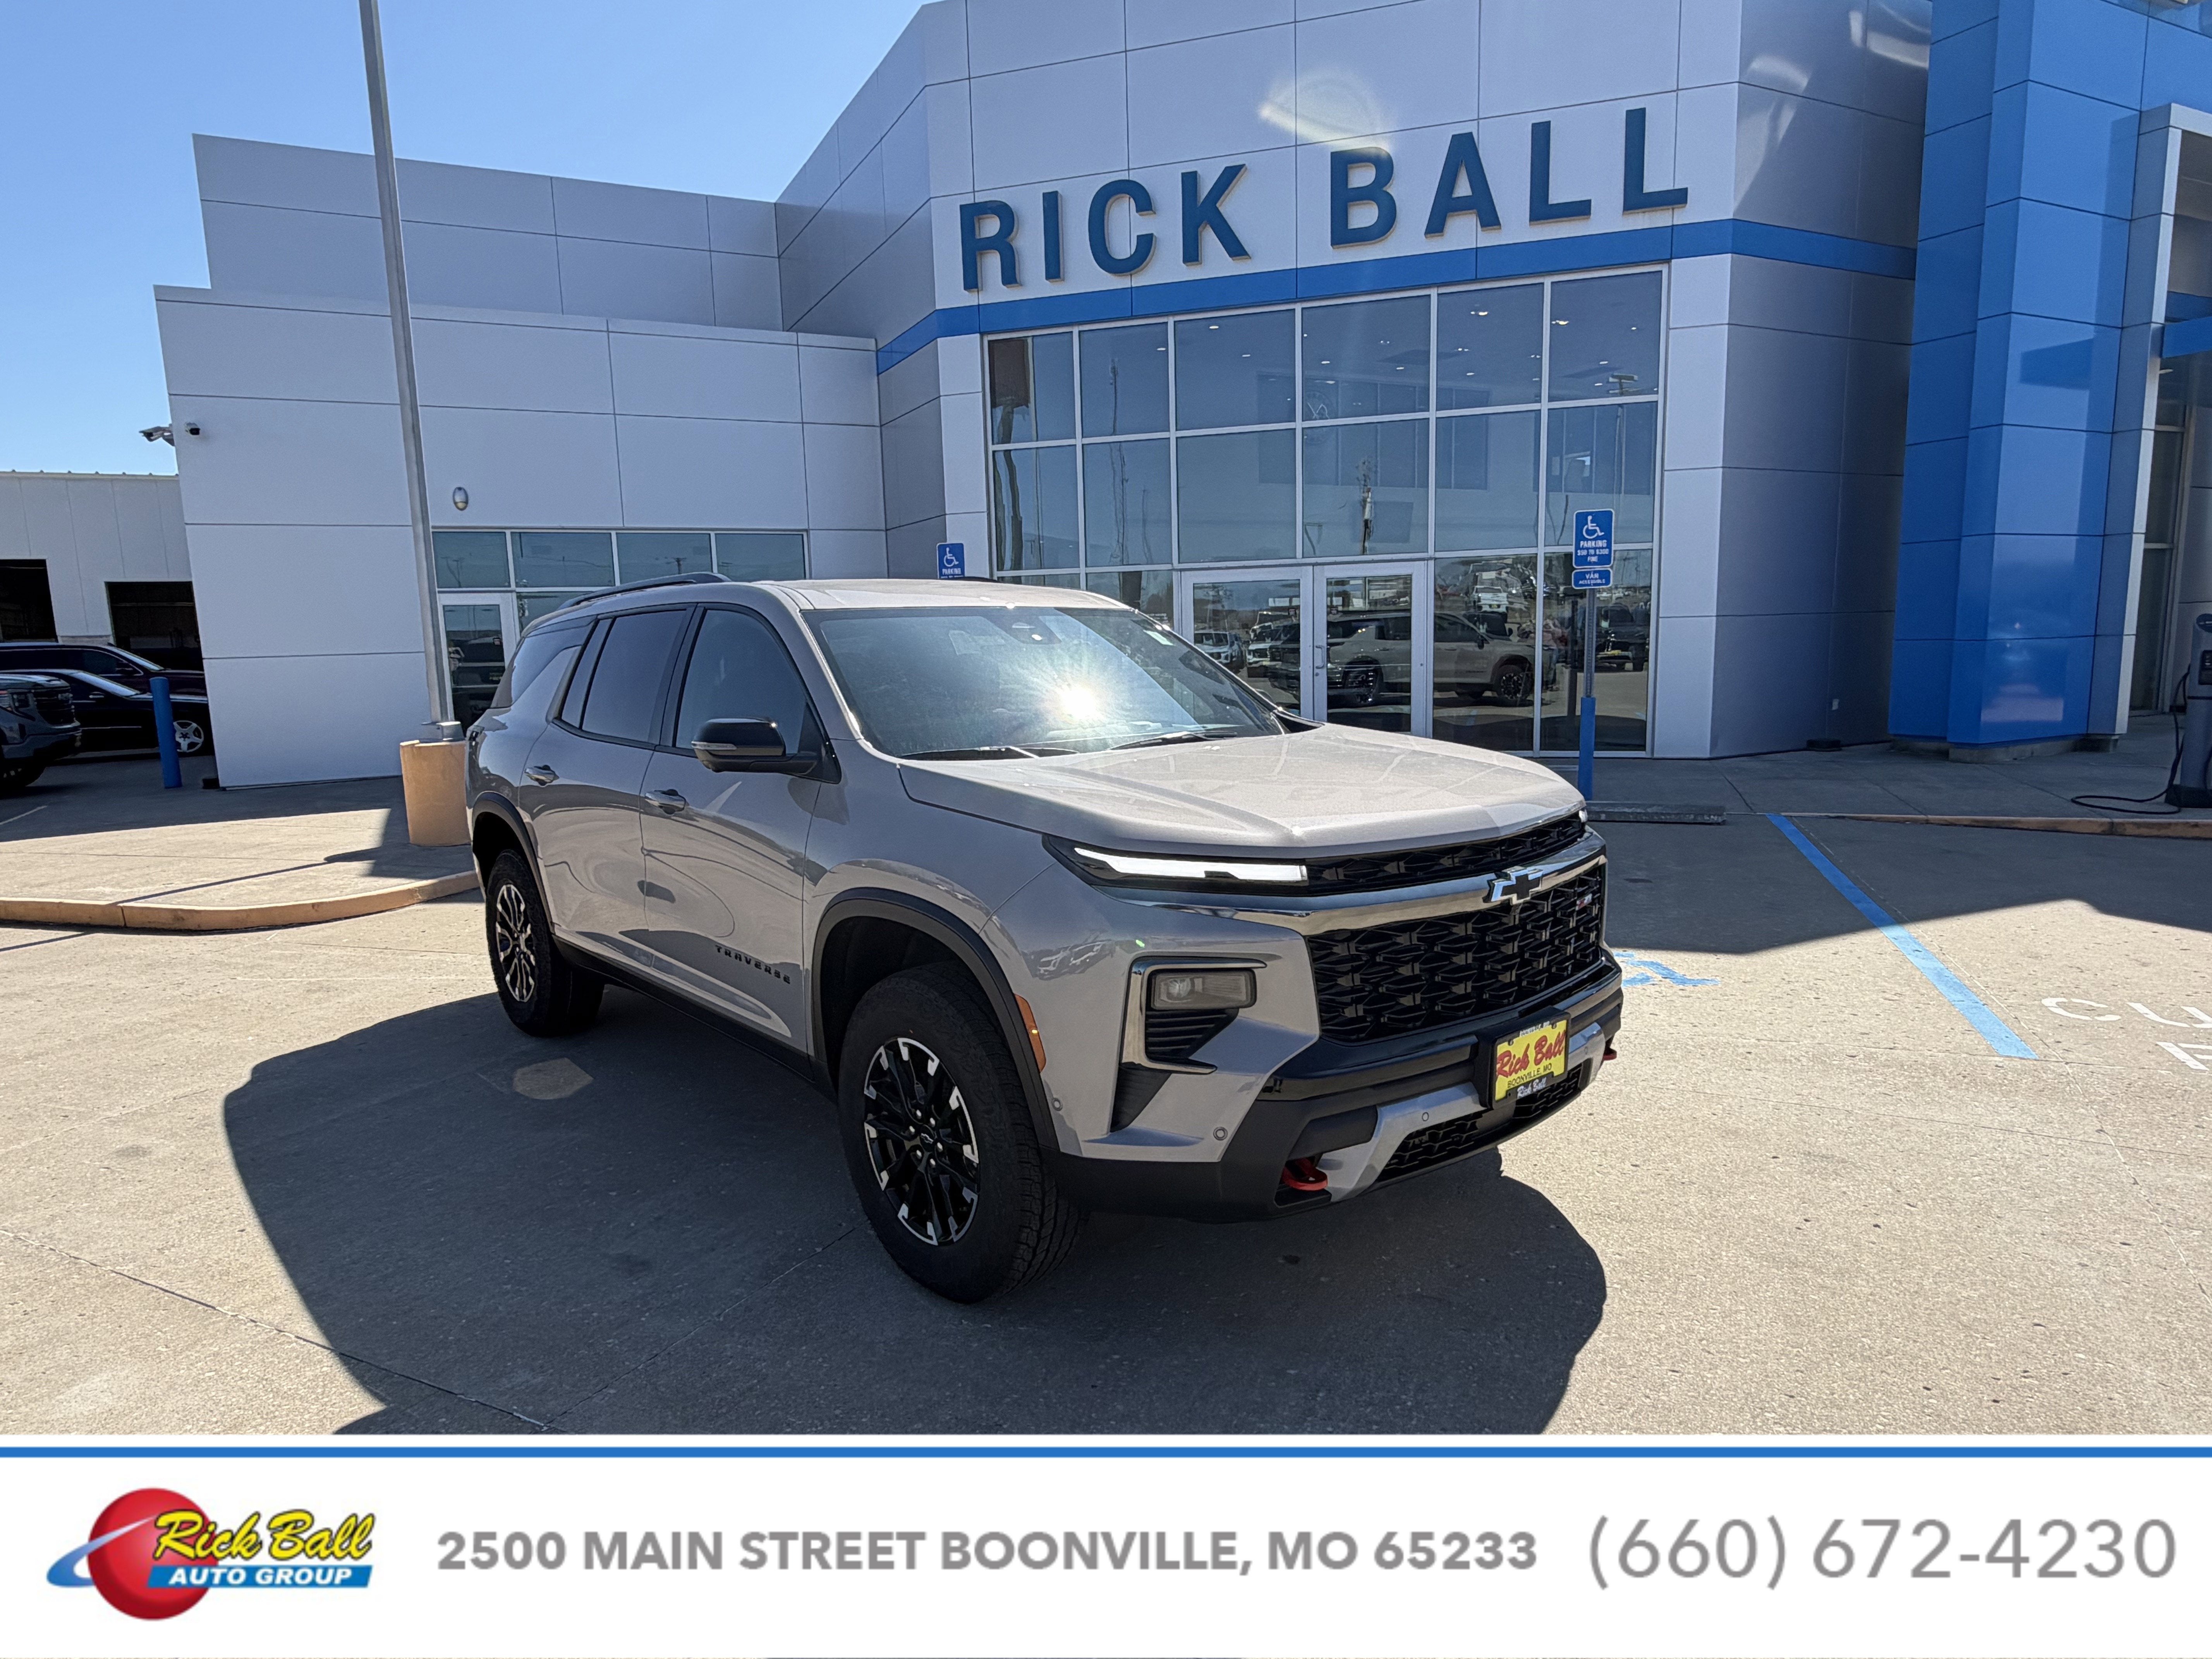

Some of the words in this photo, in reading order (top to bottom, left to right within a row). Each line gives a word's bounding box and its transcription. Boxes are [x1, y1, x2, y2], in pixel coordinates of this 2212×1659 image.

[959, 163, 1252, 292] RICK
[1330, 107, 1689, 249] BALL
[1580, 540, 1607, 548] PARKING
[715, 945, 790, 984] TRAVERSE
[1496, 1042, 1530, 1078] Rick
[1534, 1029, 1566, 1066] Ball
[1543, 1063, 1552, 1073] MO
